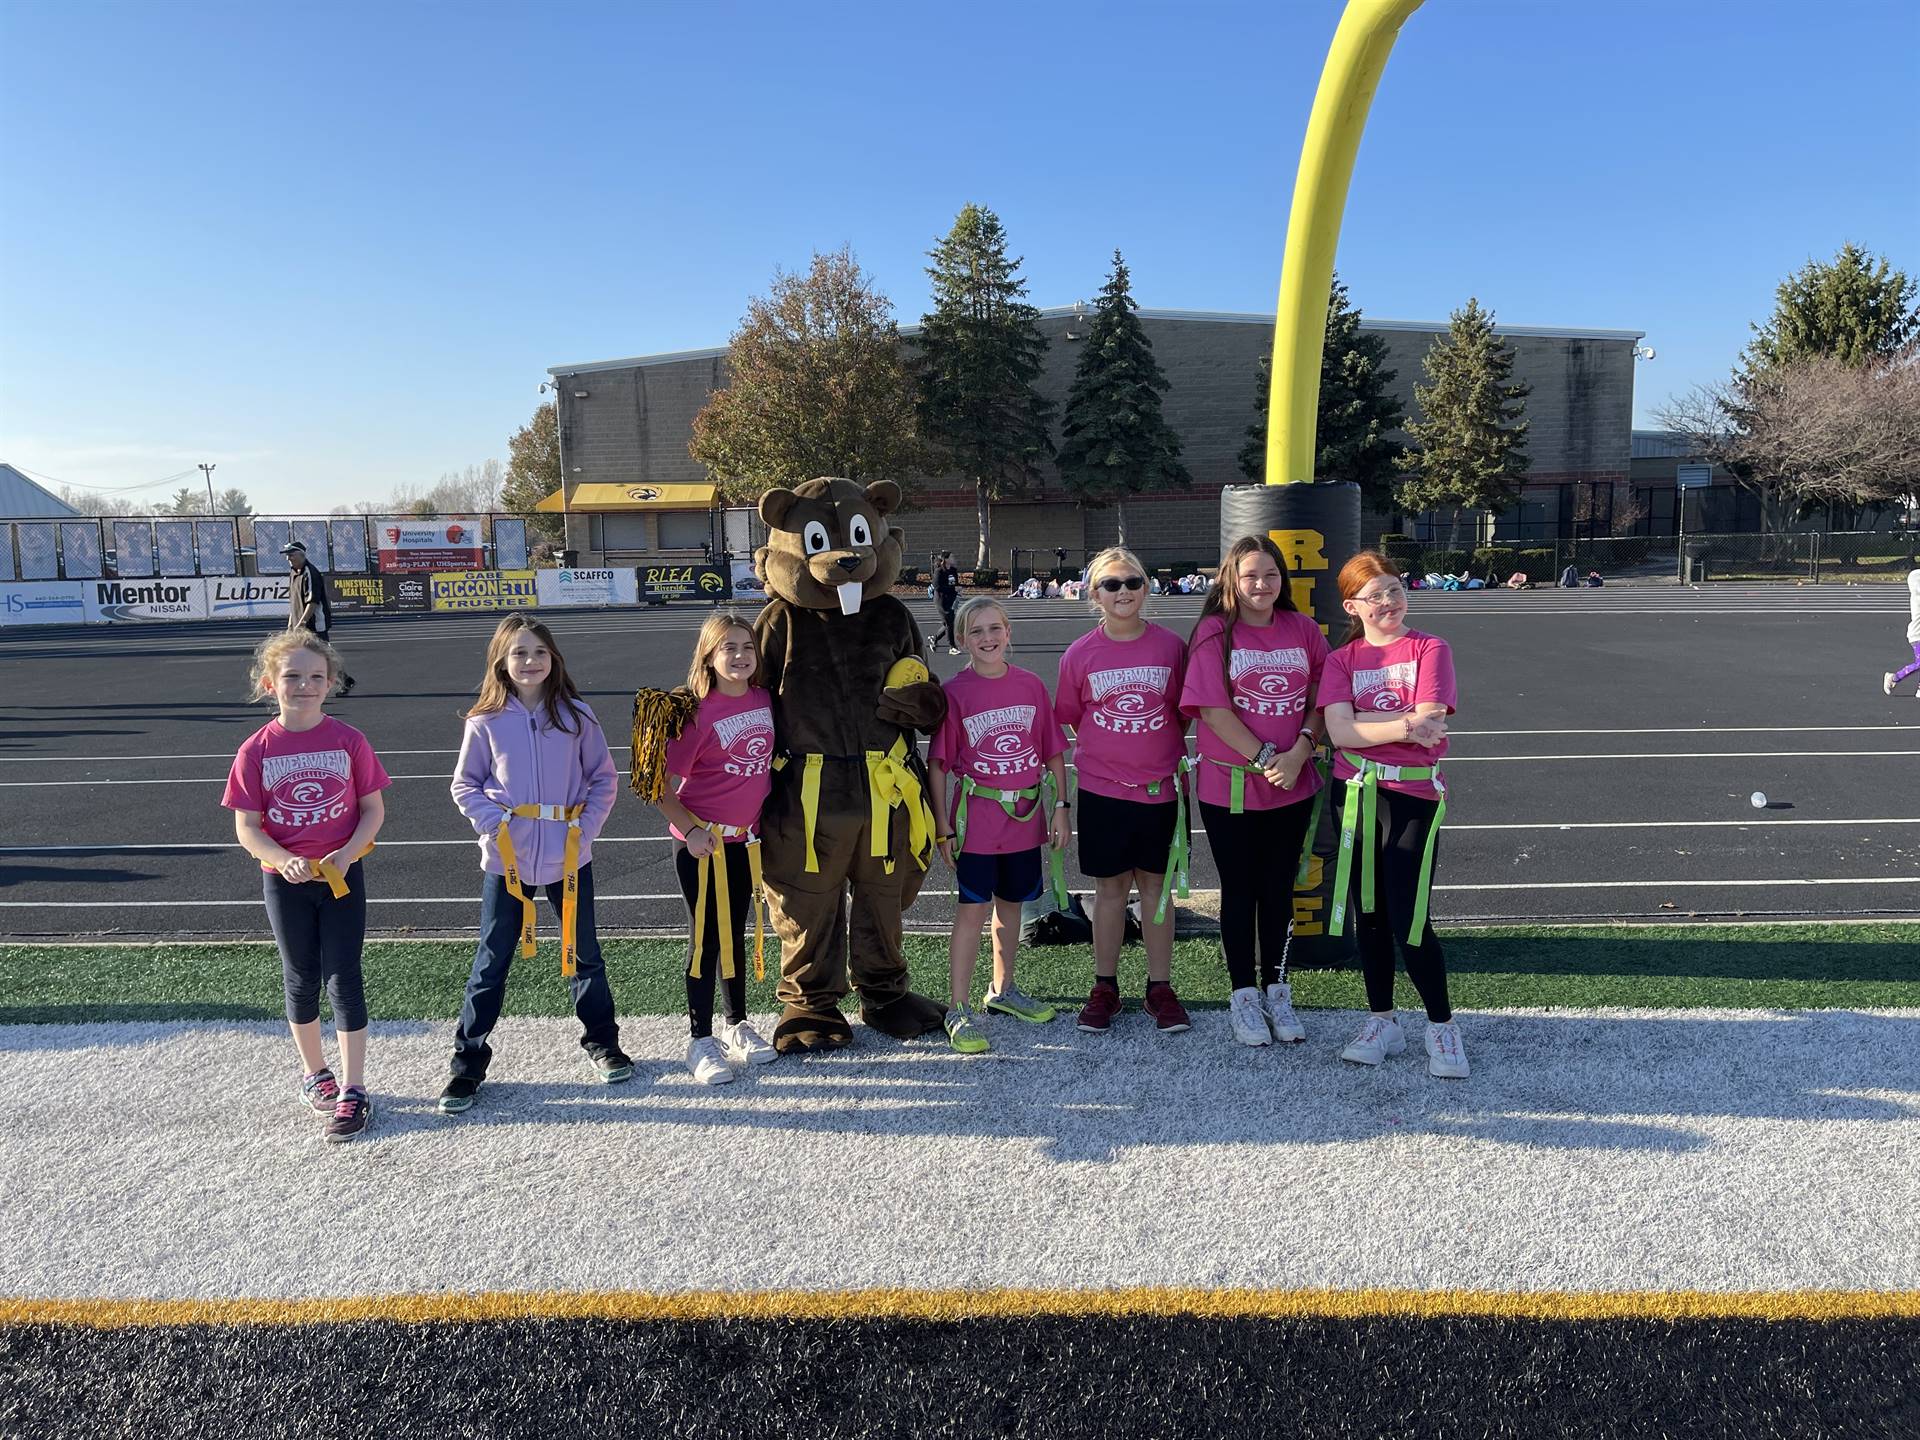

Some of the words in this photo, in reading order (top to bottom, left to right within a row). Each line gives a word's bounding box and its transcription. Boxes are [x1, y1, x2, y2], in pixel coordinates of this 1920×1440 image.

[402, 530, 435, 538] University
[573, 571, 614, 580] SCAFFCO
[647, 567, 693, 582] RLEA
[334, 579, 383, 588] PAINESVILLE'S
[398, 583, 423, 591] Claire
[437, 580, 533, 597] CICCONETTI
[654, 584, 688, 592] Riverside
[97, 582, 191, 604] Mentor
[342, 588, 359, 597] REAL
[360, 587, 384, 596] ESTATE
[445, 598, 528, 608] TRUSTEE
[150, 605, 191, 613] NISSAN
[1230, 648, 1310, 680] RIVERVIEW
[1088, 666, 1171, 701] RIVERVIEW
[262, 750, 352, 791] RIVERVIEW
[268, 802, 349, 827] G.F.F.C.
